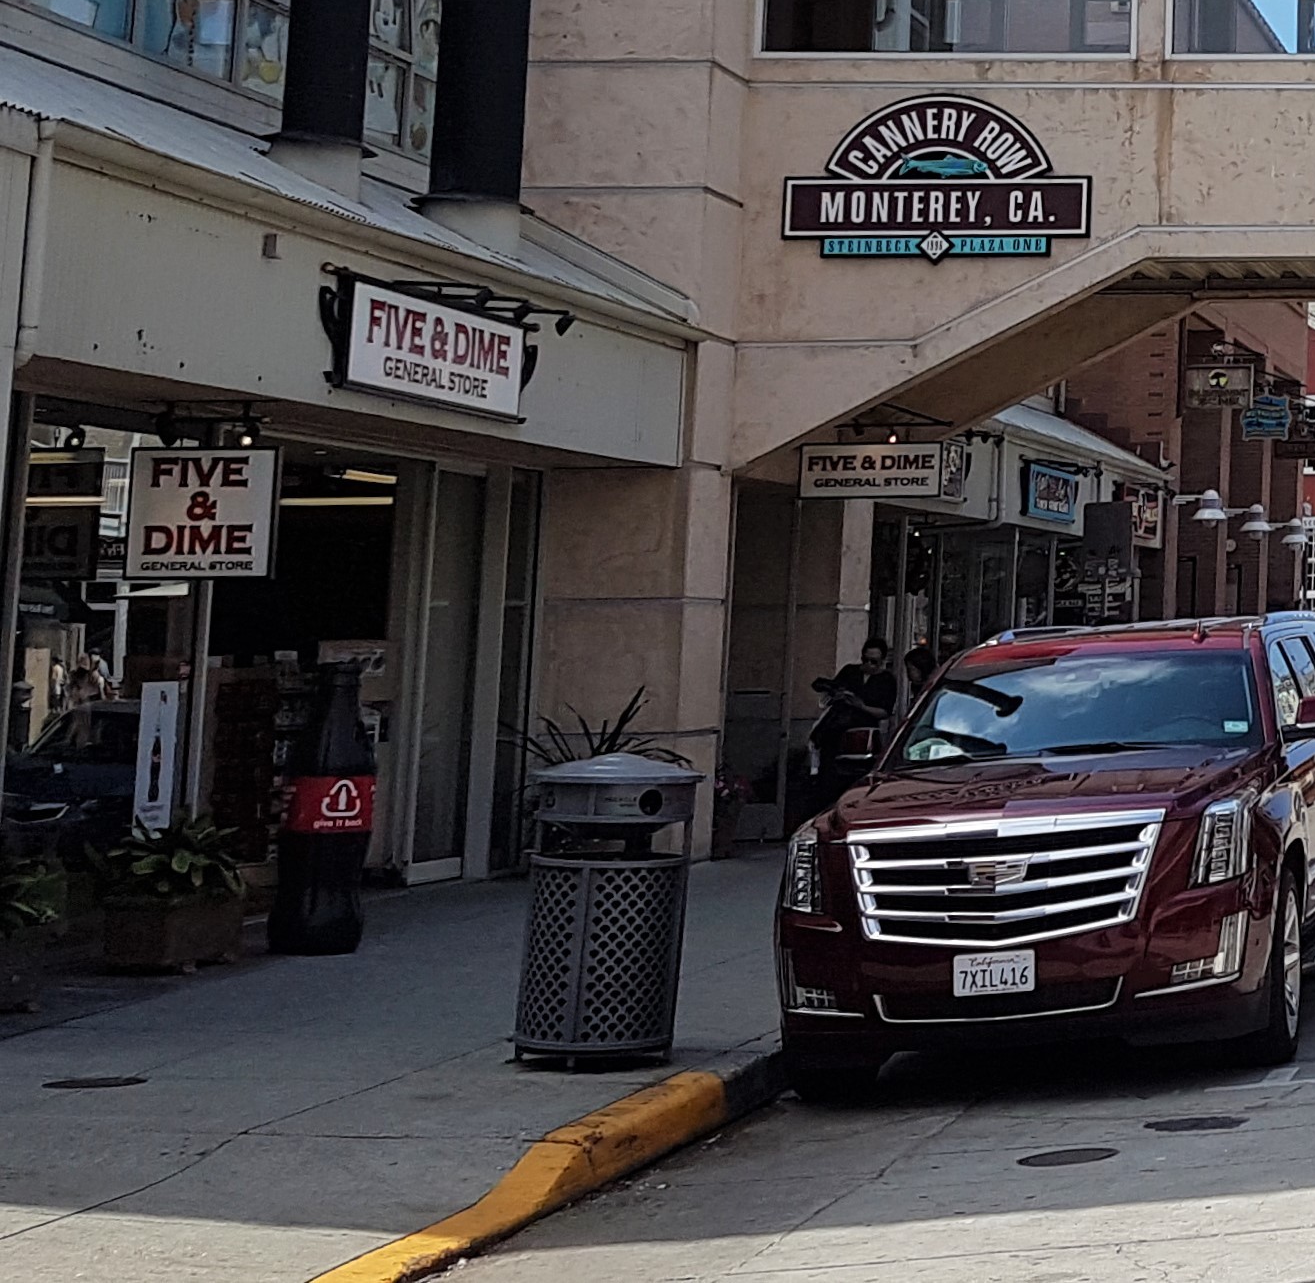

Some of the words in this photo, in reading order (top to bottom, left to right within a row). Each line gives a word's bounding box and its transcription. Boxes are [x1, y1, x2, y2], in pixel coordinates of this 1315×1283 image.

[849, 107, 976, 176] CANNERY
[972, 121, 1033, 175] ROW
[819, 191, 992, 226] MONTEREY,
[1009, 190, 1056, 223] CA.
[828, 240, 911, 252] STEINBECK
[961, 239, 1004, 251] PLAZA
[1013, 239, 1042, 251] ONE
[367, 298, 427, 358] FIVE
[431, 316, 449, 362] &
[452, 322, 511, 379] DIME
[383, 356, 446, 390] GENERAL
[449, 372, 488, 399] STORE
[150, 455, 250, 488] FIVE
[808, 455, 857, 472] FIVE
[860, 455, 877, 471] &
[881, 454, 935, 470] DIME
[813, 477, 881, 488] GENERAL
[883, 477, 929, 487] STORE
[186, 490, 218, 522] &
[141, 523, 254, 556] DIME
[140, 560, 206, 572] GENERAL
[208, 560, 253, 571] STORE
[313, 820, 334, 829] give
[958, 966, 1029, 991] 7XIL416
